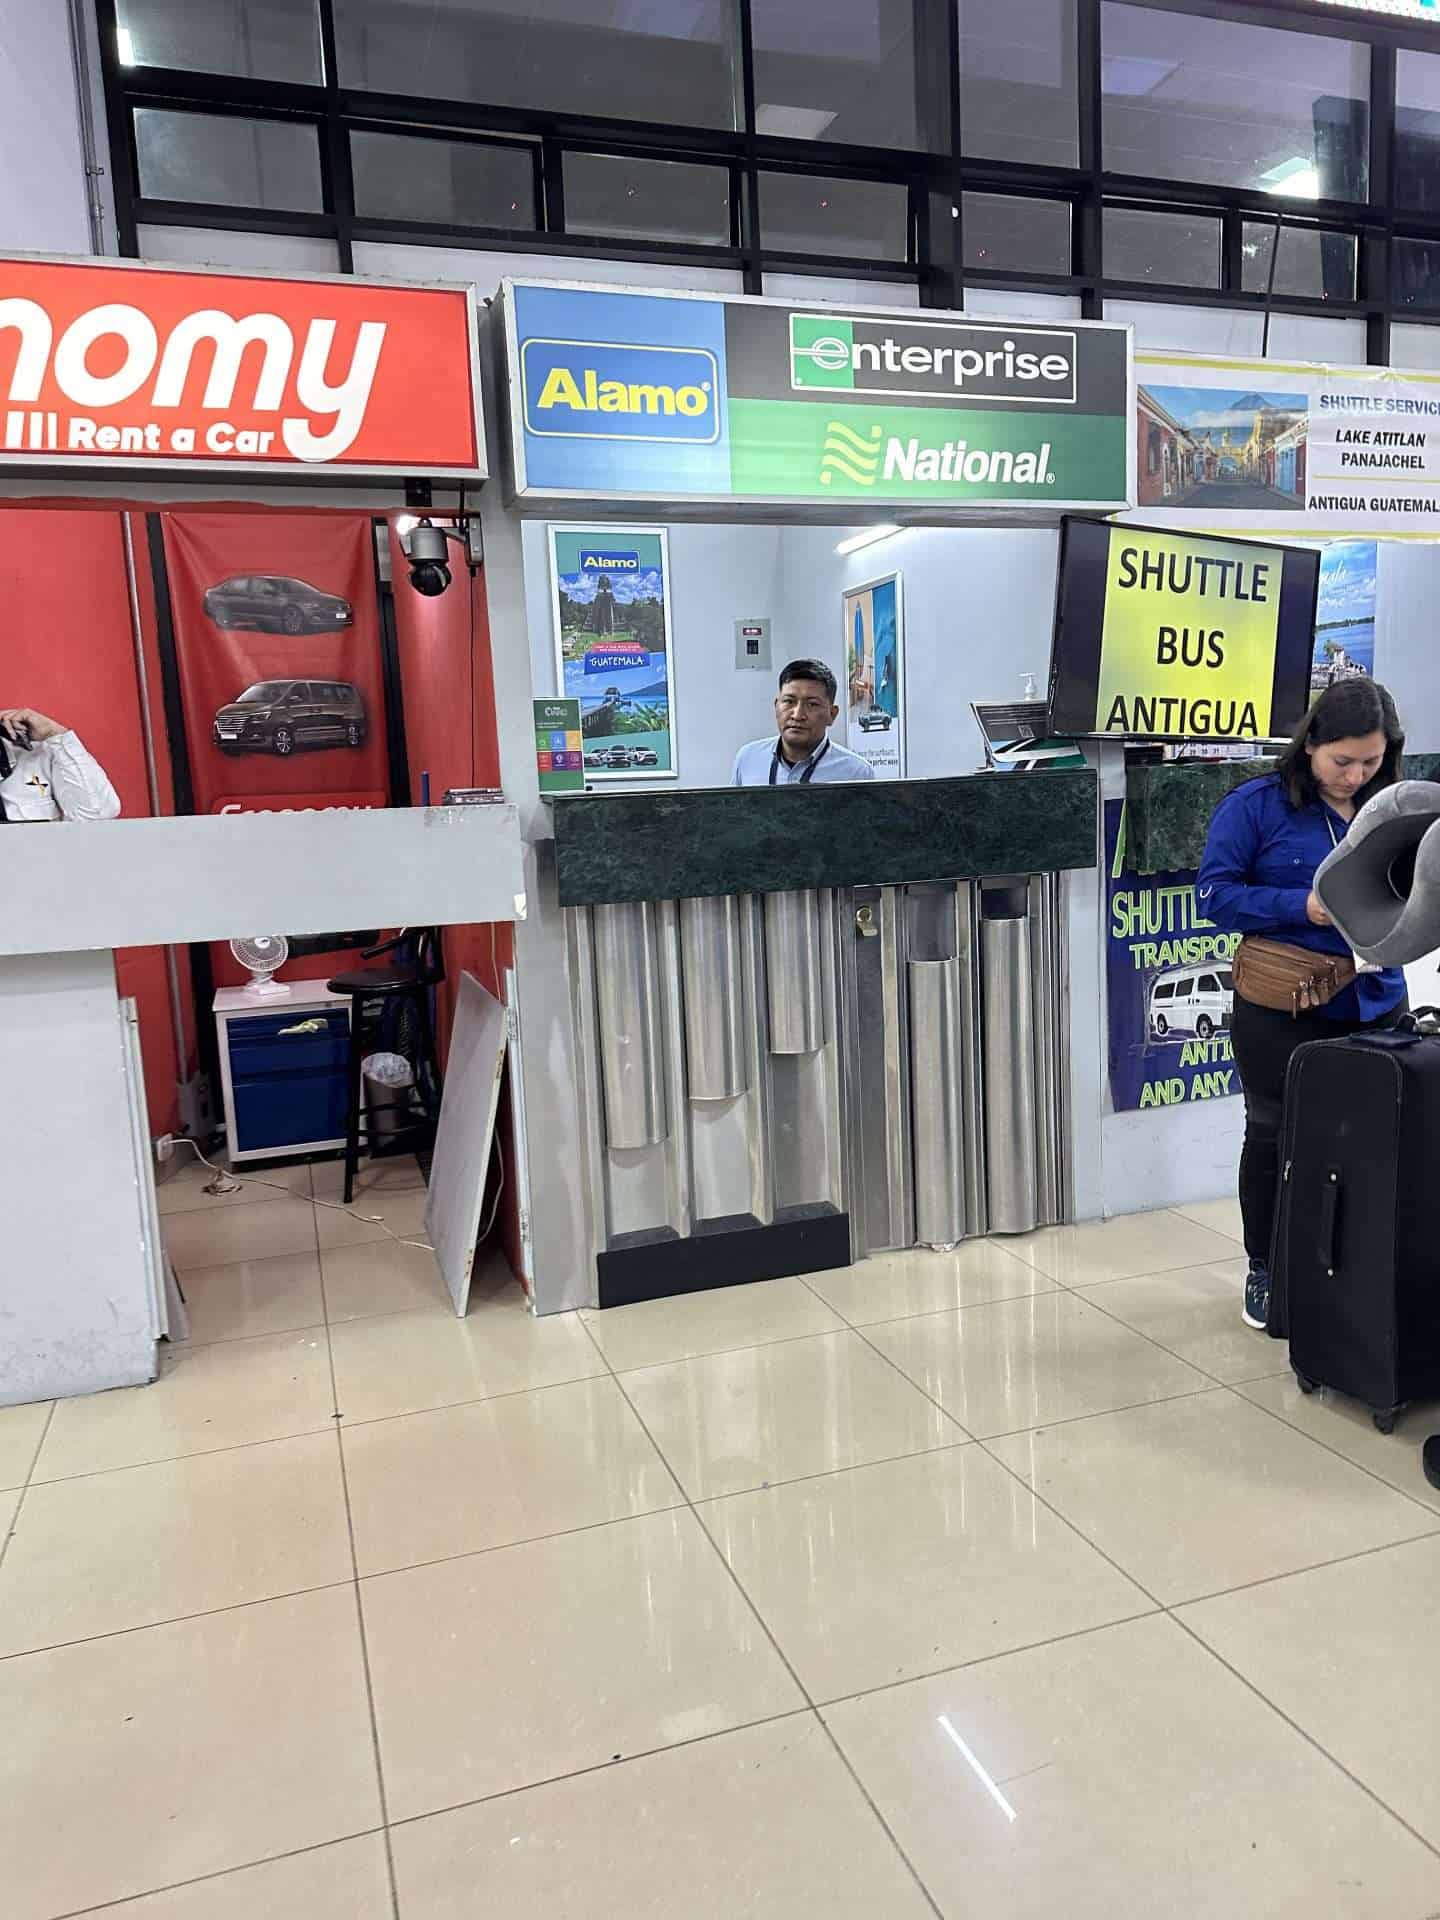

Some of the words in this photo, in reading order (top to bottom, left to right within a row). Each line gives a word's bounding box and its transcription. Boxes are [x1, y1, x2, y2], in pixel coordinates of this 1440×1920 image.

[811, 337, 1070, 386] enterprise
[537, 367, 709, 416] Alamo
[1319, 394, 1384, 413] SHUTTLE
[1386, 398, 1440, 416] SERVIC
[67, 417, 161, 451] Rent
[170, 428, 196, 452] a
[206, 422, 275, 454] Car
[1335, 428, 1371, 444] LAKE
[1373, 431, 1426, 447] ATITLAN
[1341, 452, 1425, 469] PANAJACHEL
[1308, 496, 1367, 511] ANTIGUA
[1369, 498, 1440, 513] GUATEMAL
[584, 556, 637, 568] Alamo
[1118, 547, 1270, 602] SHUTTLE
[591, 656, 643, 667] GUATEMALA
[1156, 626, 1225, 669] BUS
[1105, 695, 1258, 736] ANTIGUA
[1139, 1078, 1186, 1109] AND
[1190, 1069, 1234, 1100] ANY
